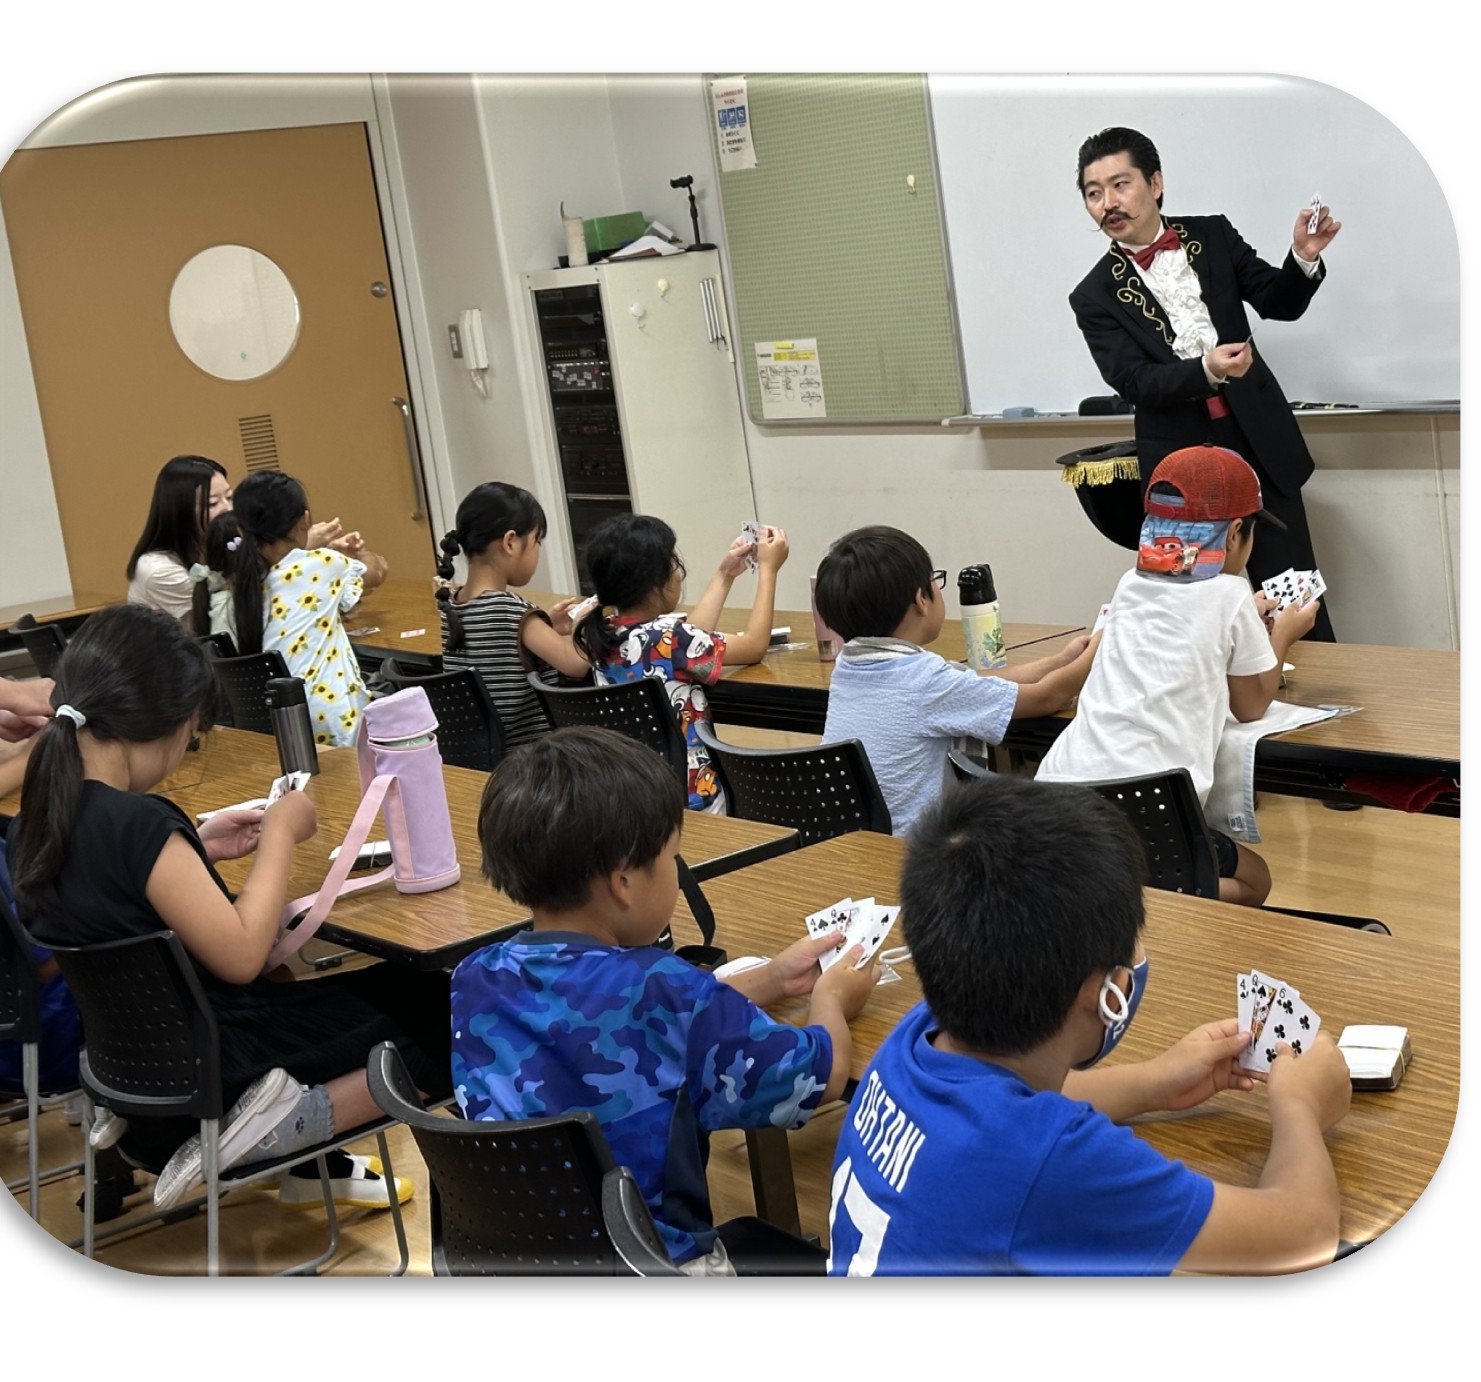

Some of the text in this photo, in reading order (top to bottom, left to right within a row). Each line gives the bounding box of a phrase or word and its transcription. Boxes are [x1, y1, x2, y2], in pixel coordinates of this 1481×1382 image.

[830, 908, 837, 919] Q
[1240, 978, 1246, 990] 4
[1252, 974, 1258, 987] Q
[1279, 987, 1286, 999] 6
[853, 1069, 926, 1194] OHTANI
